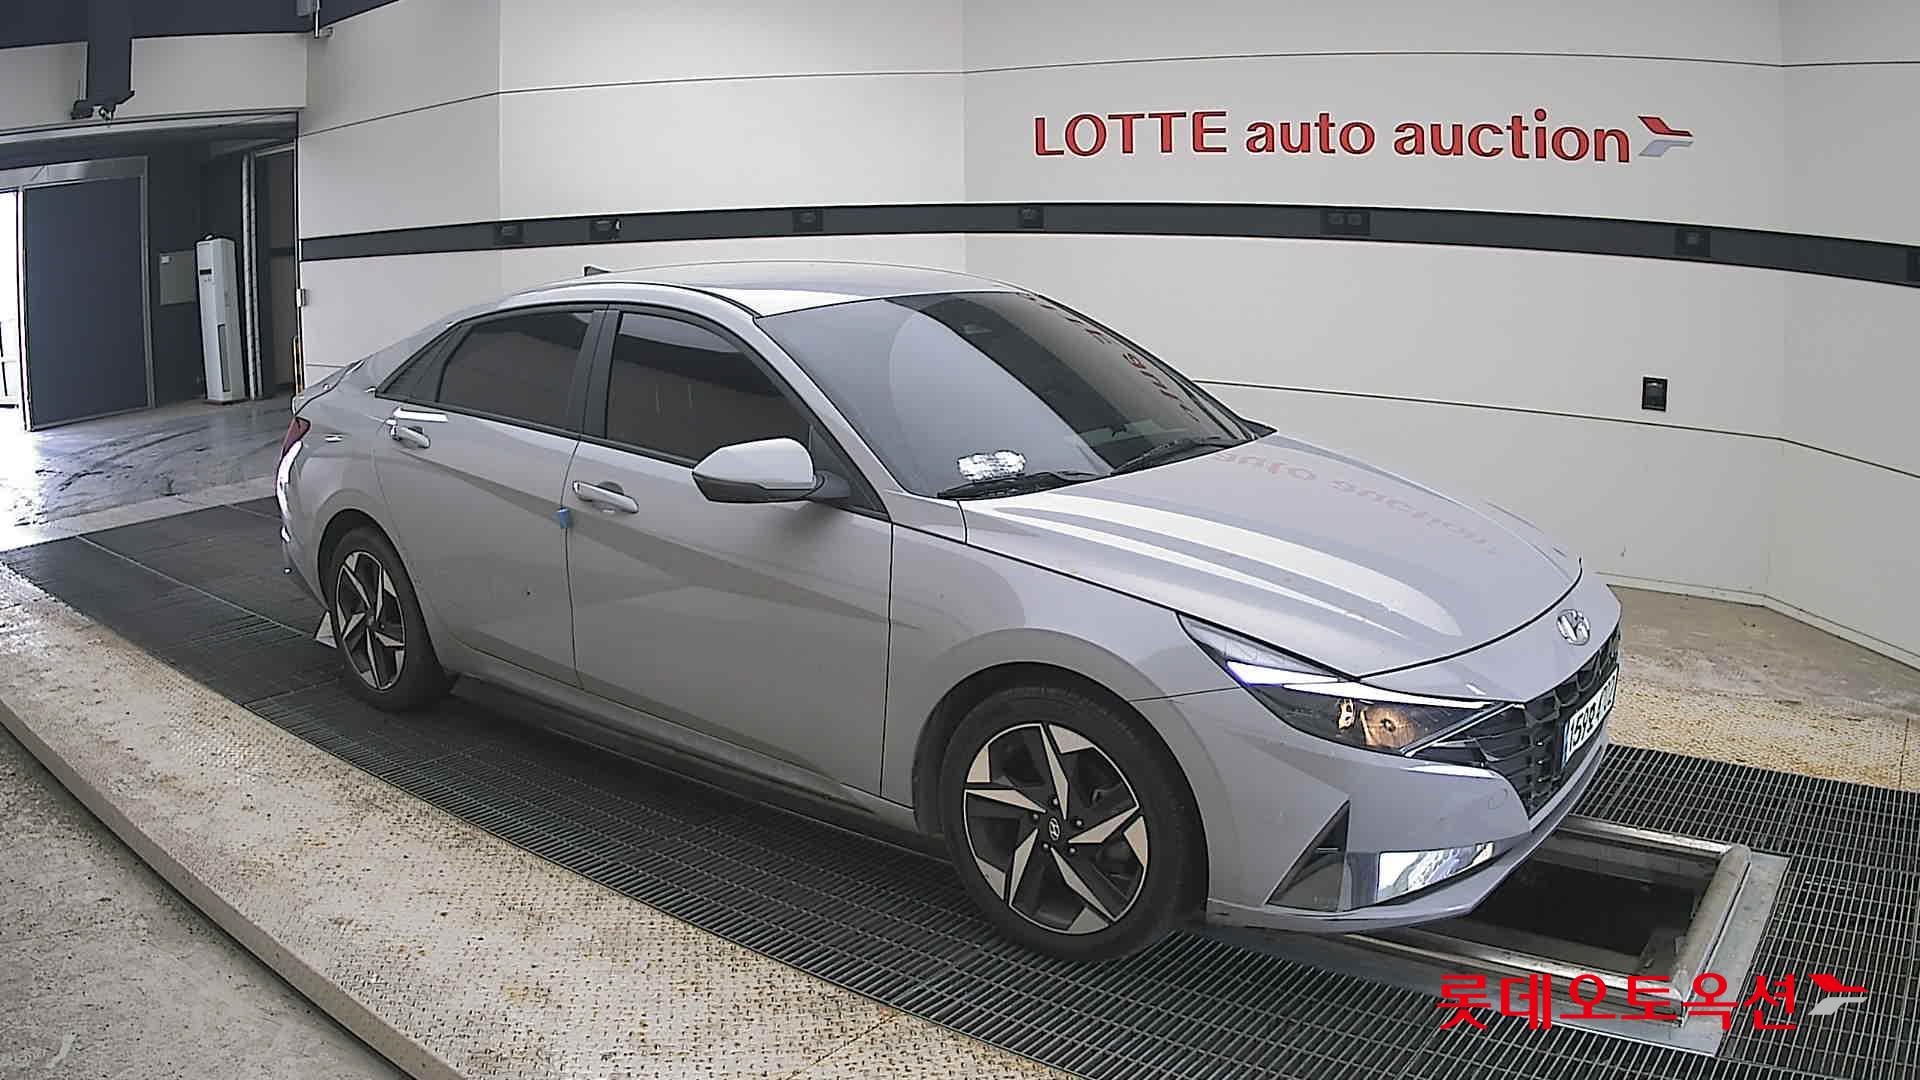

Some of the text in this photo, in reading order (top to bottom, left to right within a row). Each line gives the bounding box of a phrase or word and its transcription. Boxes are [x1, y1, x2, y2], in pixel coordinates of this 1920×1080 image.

[1034, 107, 1630, 164] LOTTE auto auction
